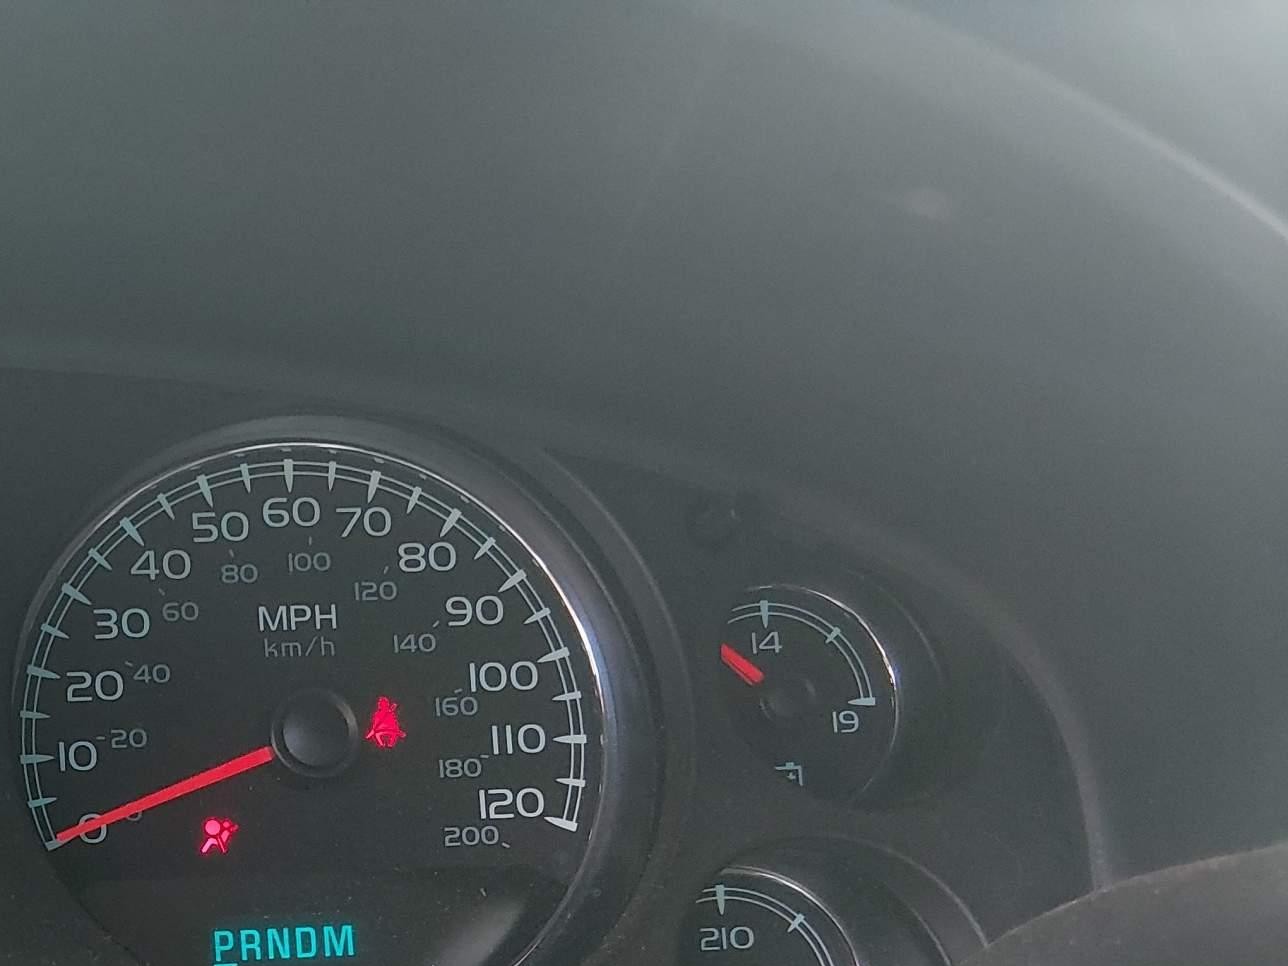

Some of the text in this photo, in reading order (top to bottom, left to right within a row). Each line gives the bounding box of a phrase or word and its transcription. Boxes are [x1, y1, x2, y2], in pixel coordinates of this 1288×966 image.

[261, 497, 321, 528] 60
[335, 506, 392, 538] 70
[190, 510, 249, 543] 50
[130, 549, 192, 580] 40
[287, 552, 332, 573] 100
[397, 542, 457, 573] 80
[220, 562, 258, 584] 80
[353, 580, 398, 602] 120
[93, 606, 151, 639] 30
[162, 601, 199, 622] 60
[257, 604, 338, 632] MPH
[445, 595, 505, 628] 90
[263, 636, 336, 658] km/h
[393, 632, 437, 653] 140
[751, 631, 783, 654] 14
[65, 670, 124, 702] 20
[132, 663, 171, 684] 40
[469, 660, 538, 692] 100
[434, 695, 478, 716] 160
[832, 710, 860, 733] 19
[111, 728, 147, 749] 20
[491, 724, 546, 755] 110
[57, 741, 97, 772] 10
[438, 757, 482, 779] 180
[478, 786, 545, 819] 120
[443, 825, 500, 847] 200
[213, 924, 356, 962] PRNDM
[699, 926, 755, 951] 210
